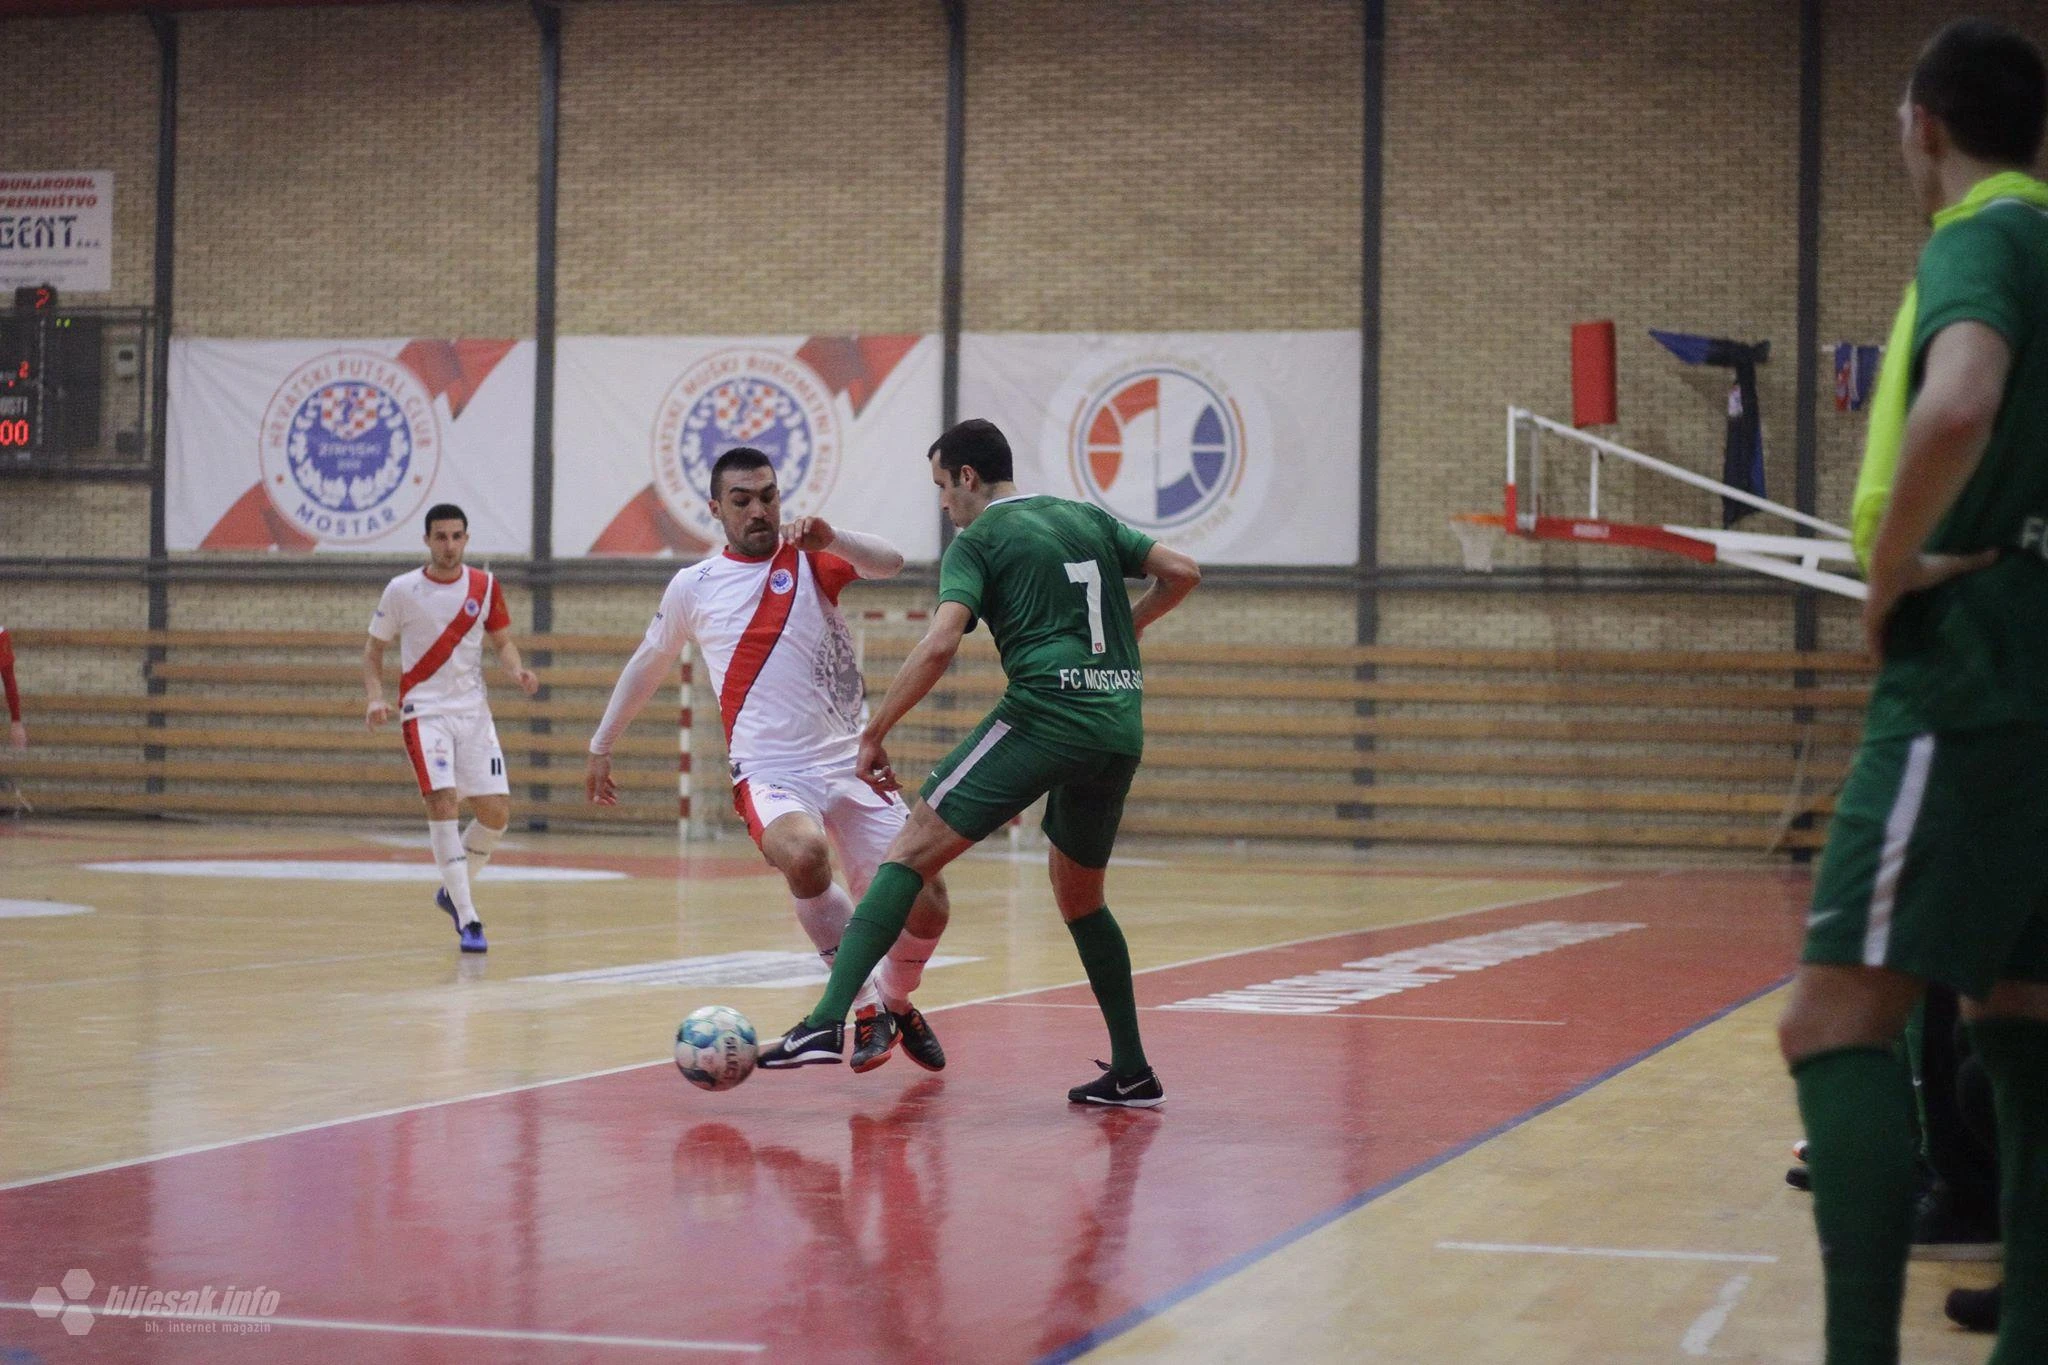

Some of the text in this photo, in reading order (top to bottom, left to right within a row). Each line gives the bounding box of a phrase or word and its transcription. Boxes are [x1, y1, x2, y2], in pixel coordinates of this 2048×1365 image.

[296, 503, 396, 536] MOSTAR
[1063, 559, 1106, 654] 7
[1060, 668, 1082, 691] FC
[490, 757, 501, 776] 11
